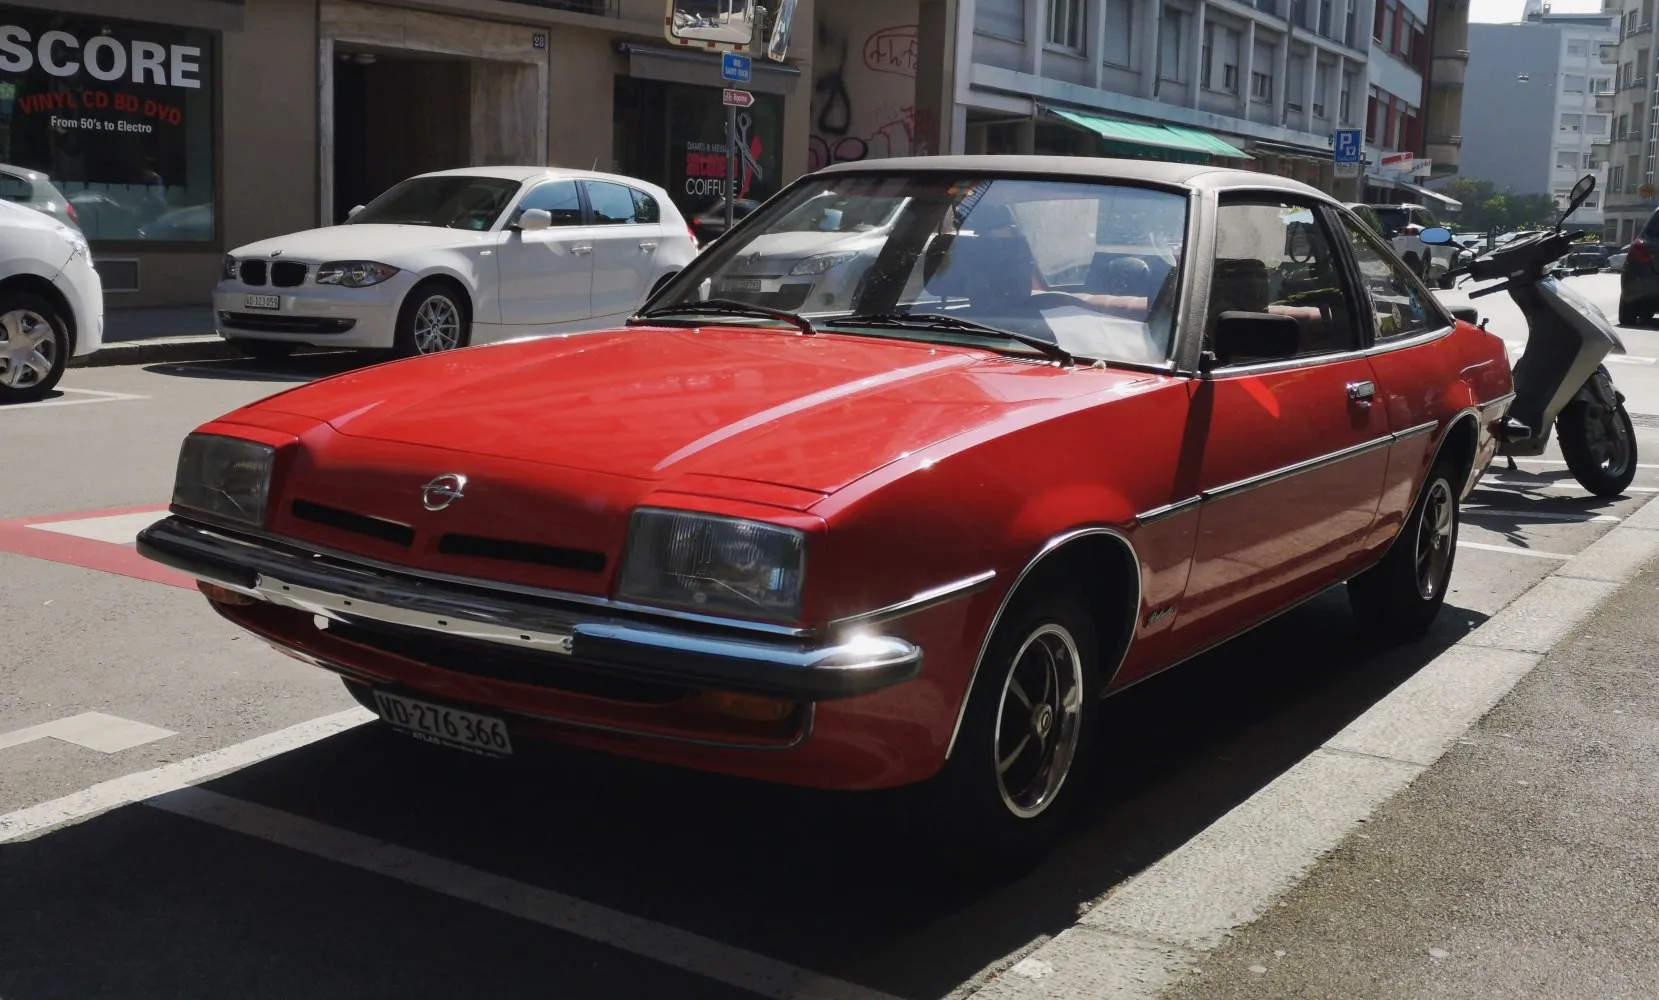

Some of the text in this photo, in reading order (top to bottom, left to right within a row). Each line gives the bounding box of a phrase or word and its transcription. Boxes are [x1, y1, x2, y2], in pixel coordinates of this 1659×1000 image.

[534, 35, 544, 47] 28
[0, 25, 201, 89] SCORE
[19, 90, 182, 126] VINYL CD BD DVD
[51, 116, 152, 133] From 50's to Electro
[1340, 133, 1352, 150] P
[685, 178, 738, 196] COIFFUE
